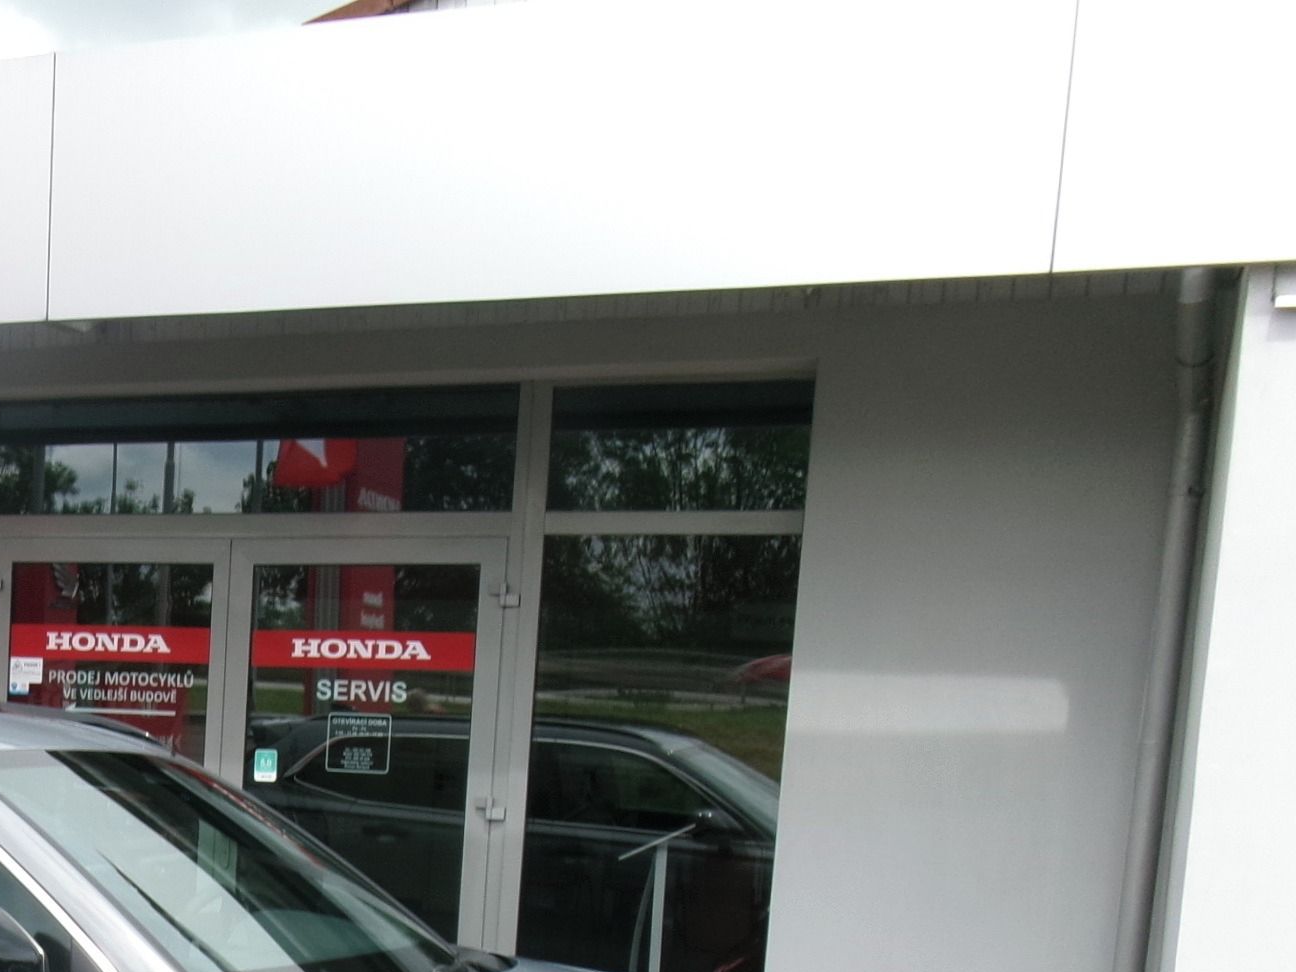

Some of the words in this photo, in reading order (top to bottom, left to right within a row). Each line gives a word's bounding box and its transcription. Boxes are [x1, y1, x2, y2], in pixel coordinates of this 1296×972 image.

[46, 631, 171, 653] HONDA
[291, 638, 431, 660] HONDA
[48, 669, 100, 685] PRODEJ
[105, 669, 194, 688] MOTOCYKLŮ
[63, 686, 77, 700] VE
[80, 686, 127, 702] VEDLEJŠÍ
[130, 689, 177, 703] BUDOVĚ
[316, 679, 408, 703] SERVIS
